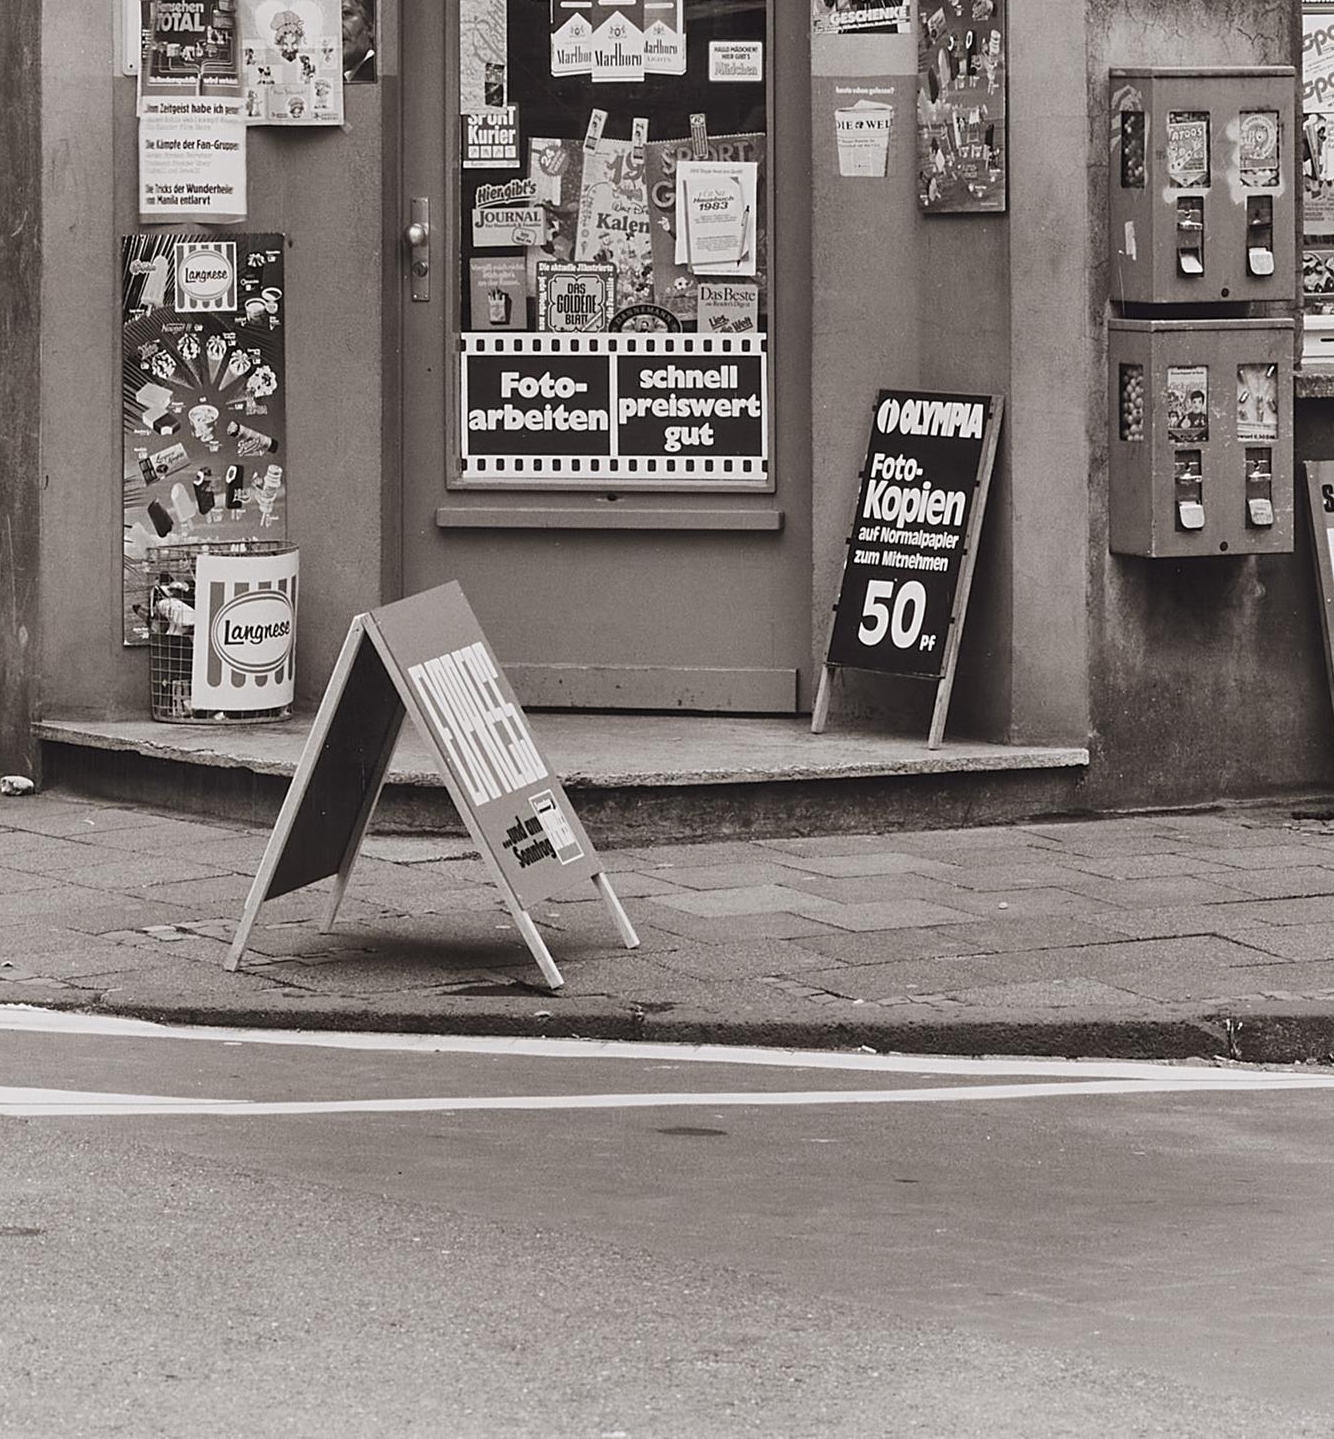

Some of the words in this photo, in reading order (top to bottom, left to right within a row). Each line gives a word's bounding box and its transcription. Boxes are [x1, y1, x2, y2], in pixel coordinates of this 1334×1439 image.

[157, 12, 205, 32] TOTAL
[594, 43, 643, 67] Marlboro
[191, 103, 212, 114] habe
[213, 103, 224, 114] ich
[183, 139, 195, 150] der
[467, 125, 516, 146] Kurier
[173, 183, 185, 194] der
[179, 195, 211, 205] entlarvt
[478, 185, 504, 204] Hier
[504, 180, 537, 200] gibt's
[698, 202, 729, 211] 1983
[474, 211, 541, 228] JOURNAL
[185, 267, 228, 283] Langnese
[568, 283, 586, 294] DAS
[701, 287, 722, 300] Das
[724, 287, 756, 301] Beste
[557, 295, 597, 313] GOLDENE
[501, 372, 587, 398] Foto-
[639, 365, 738, 389] schnell
[468, 404, 609, 431] arbeiten
[619, 394, 761, 424] preiswert
[899, 399, 984, 439] OLYMPIA
[664, 423, 714, 452] gut
[871, 453, 923, 481] Foto-
[863, 479, 966, 528] Kopien
[859, 526, 880, 543] auf
[880, 530, 959, 550] Normalpapier
[854, 548, 880, 565] zum
[881, 550, 949, 572] Mitnehmen
[857, 578, 926, 649] 50
[224, 617, 290, 646] Langnese
[407, 641, 549, 807] EXPRESS
